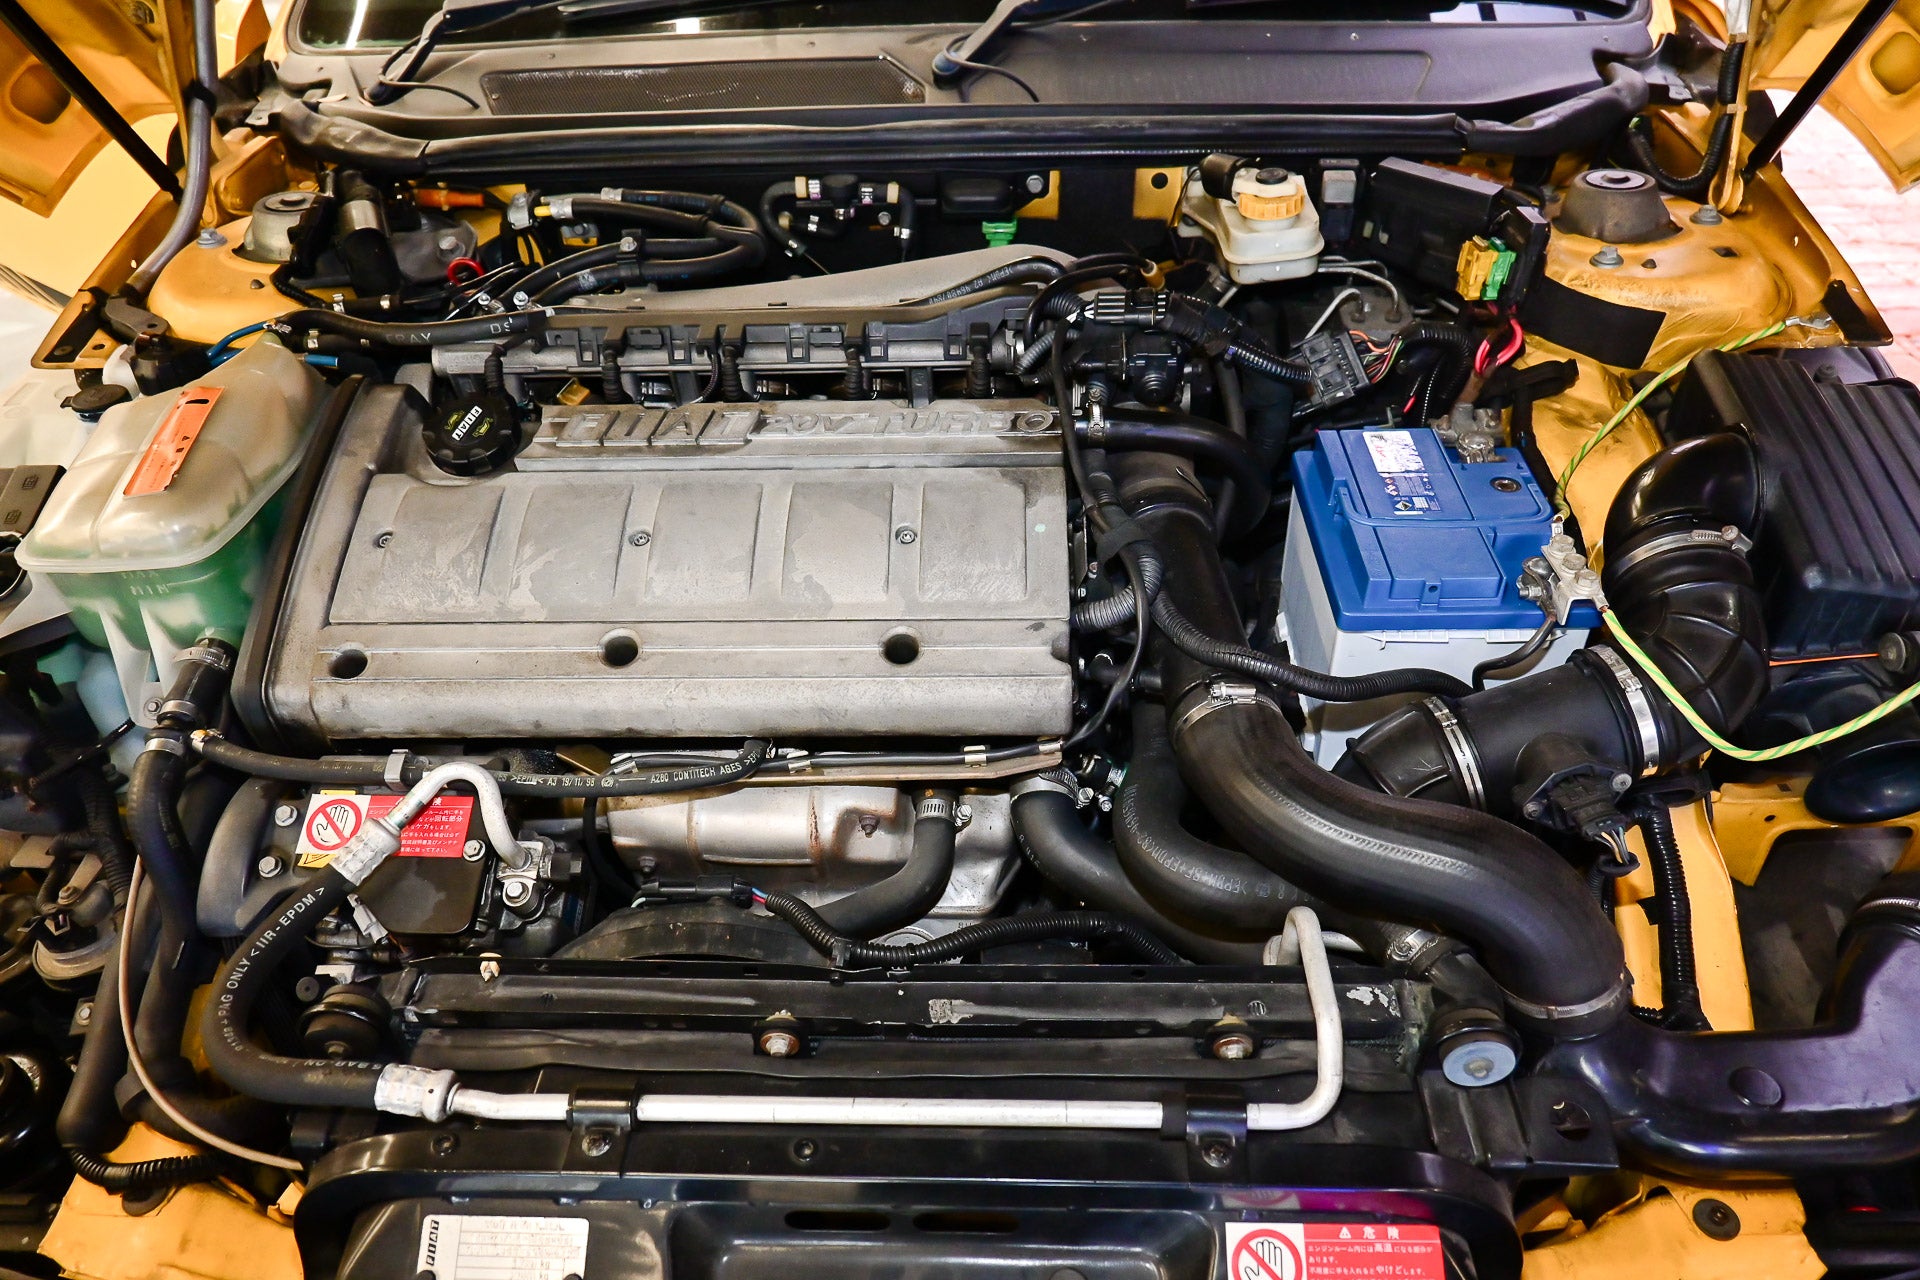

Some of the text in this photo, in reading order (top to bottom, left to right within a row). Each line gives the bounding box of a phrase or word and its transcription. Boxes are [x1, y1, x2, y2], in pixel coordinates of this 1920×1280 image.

[450, 405, 483, 441] FIAT
[870, 408, 1053, 437] TURBO
[226, 957, 251, 989] ONLY
[426, 1219, 440, 1266] FIAT
